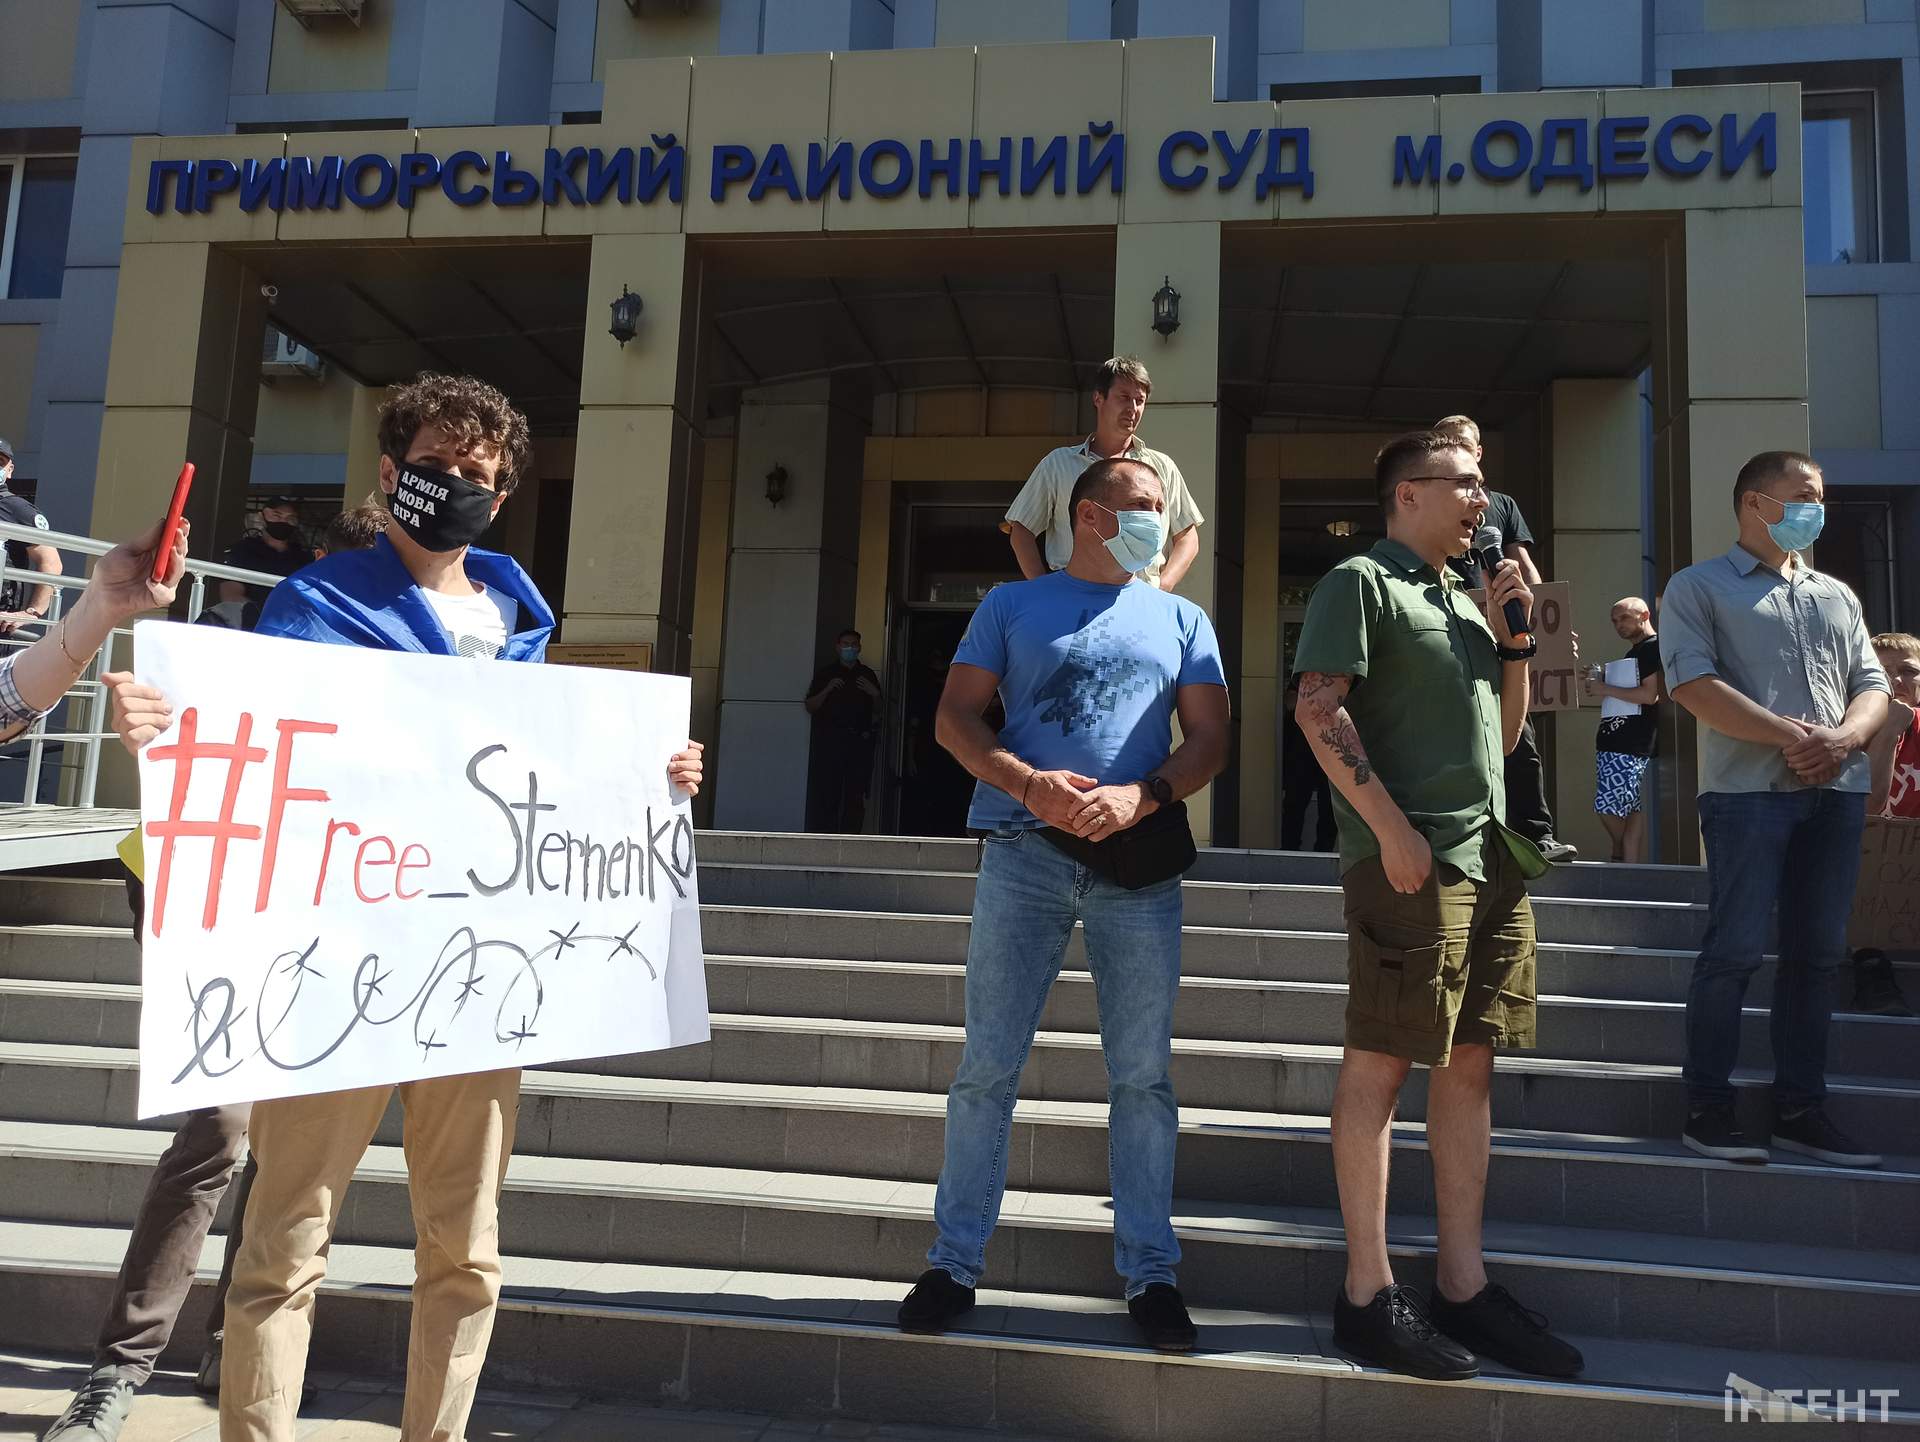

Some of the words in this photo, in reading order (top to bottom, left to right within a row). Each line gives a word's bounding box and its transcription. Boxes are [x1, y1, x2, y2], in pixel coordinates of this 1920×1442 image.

[145, 132, 685, 214] ПРИМОРСЬКИЙ
[1158, 127, 1315, 201] СУД
[397, 486, 436, 517] МОВА
[401, 469, 450, 502] АРМІЯ
[393, 502, 421, 529] ВІРА
